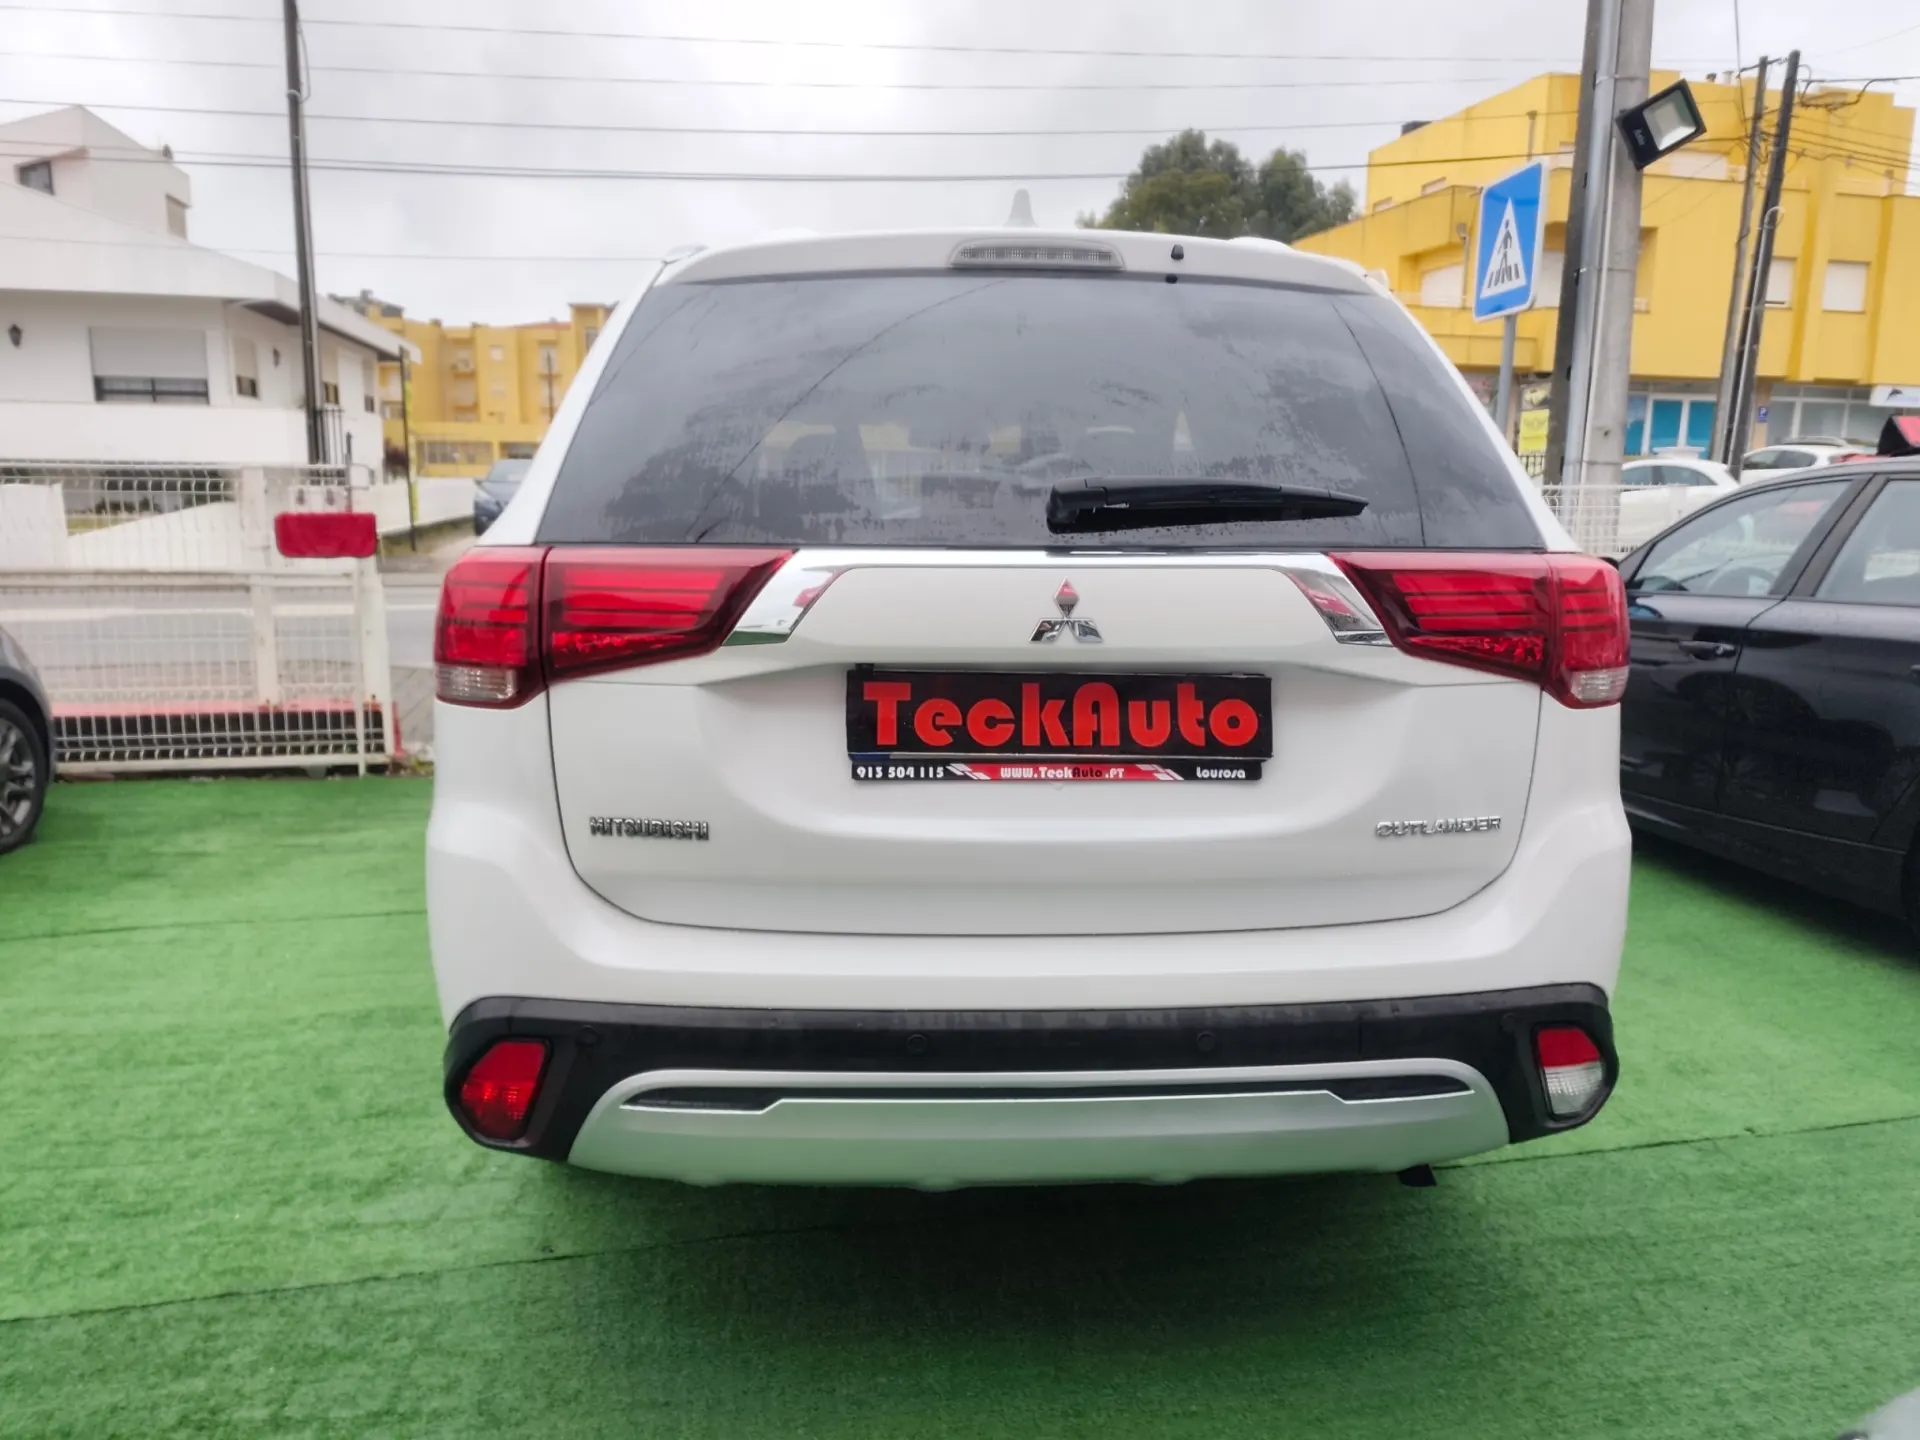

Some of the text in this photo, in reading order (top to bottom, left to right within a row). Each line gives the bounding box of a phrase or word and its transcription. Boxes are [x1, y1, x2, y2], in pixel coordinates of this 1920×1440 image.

[863, 682, 1259, 747] TeckAuto
[857, 766, 944, 778] 913 504 115
[1196, 766, 1246, 779] Lourosa
[589, 817, 709, 840] MITSUBISHI
[1376, 815, 1501, 836] OUTLANDER
